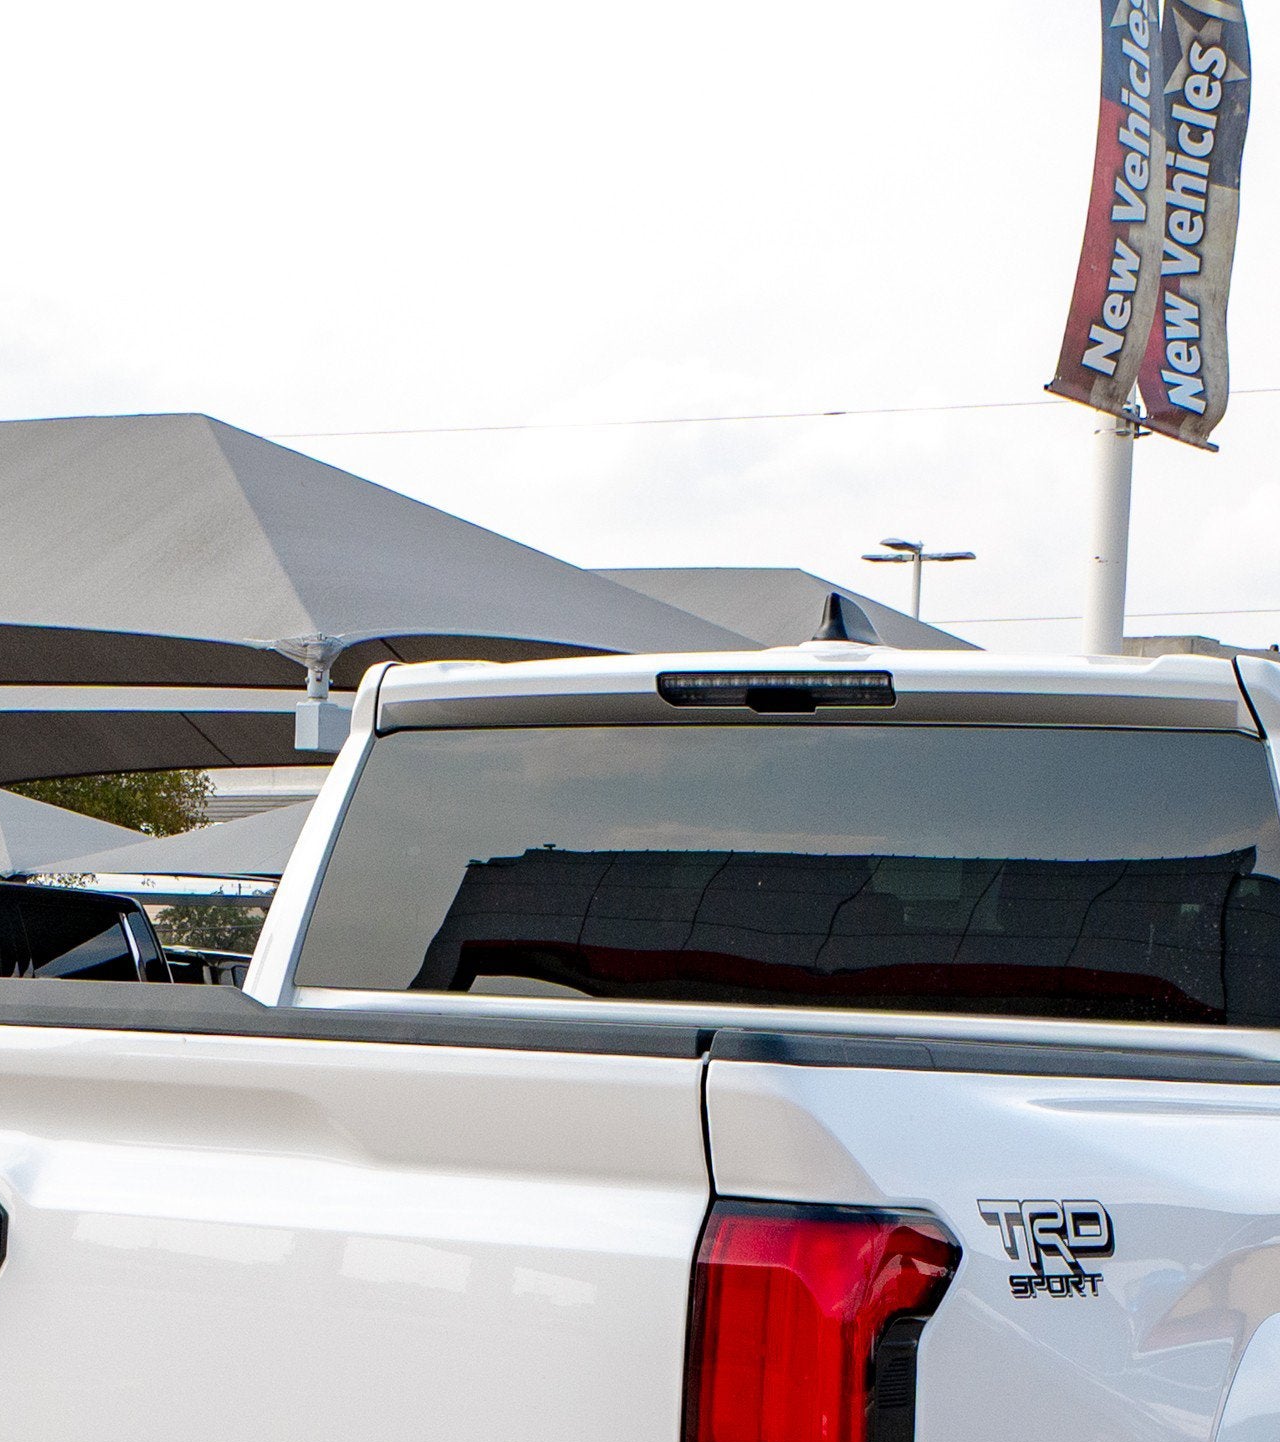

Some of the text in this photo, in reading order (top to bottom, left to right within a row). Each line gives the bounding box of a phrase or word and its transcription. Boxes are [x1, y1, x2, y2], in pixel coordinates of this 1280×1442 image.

[1161, 40, 1228, 415] New Vehicles
[1082, 238, 1141, 376] New
[976, 1199, 1116, 1276] TRD
[1009, 1273, 1103, 1298] SPORT
